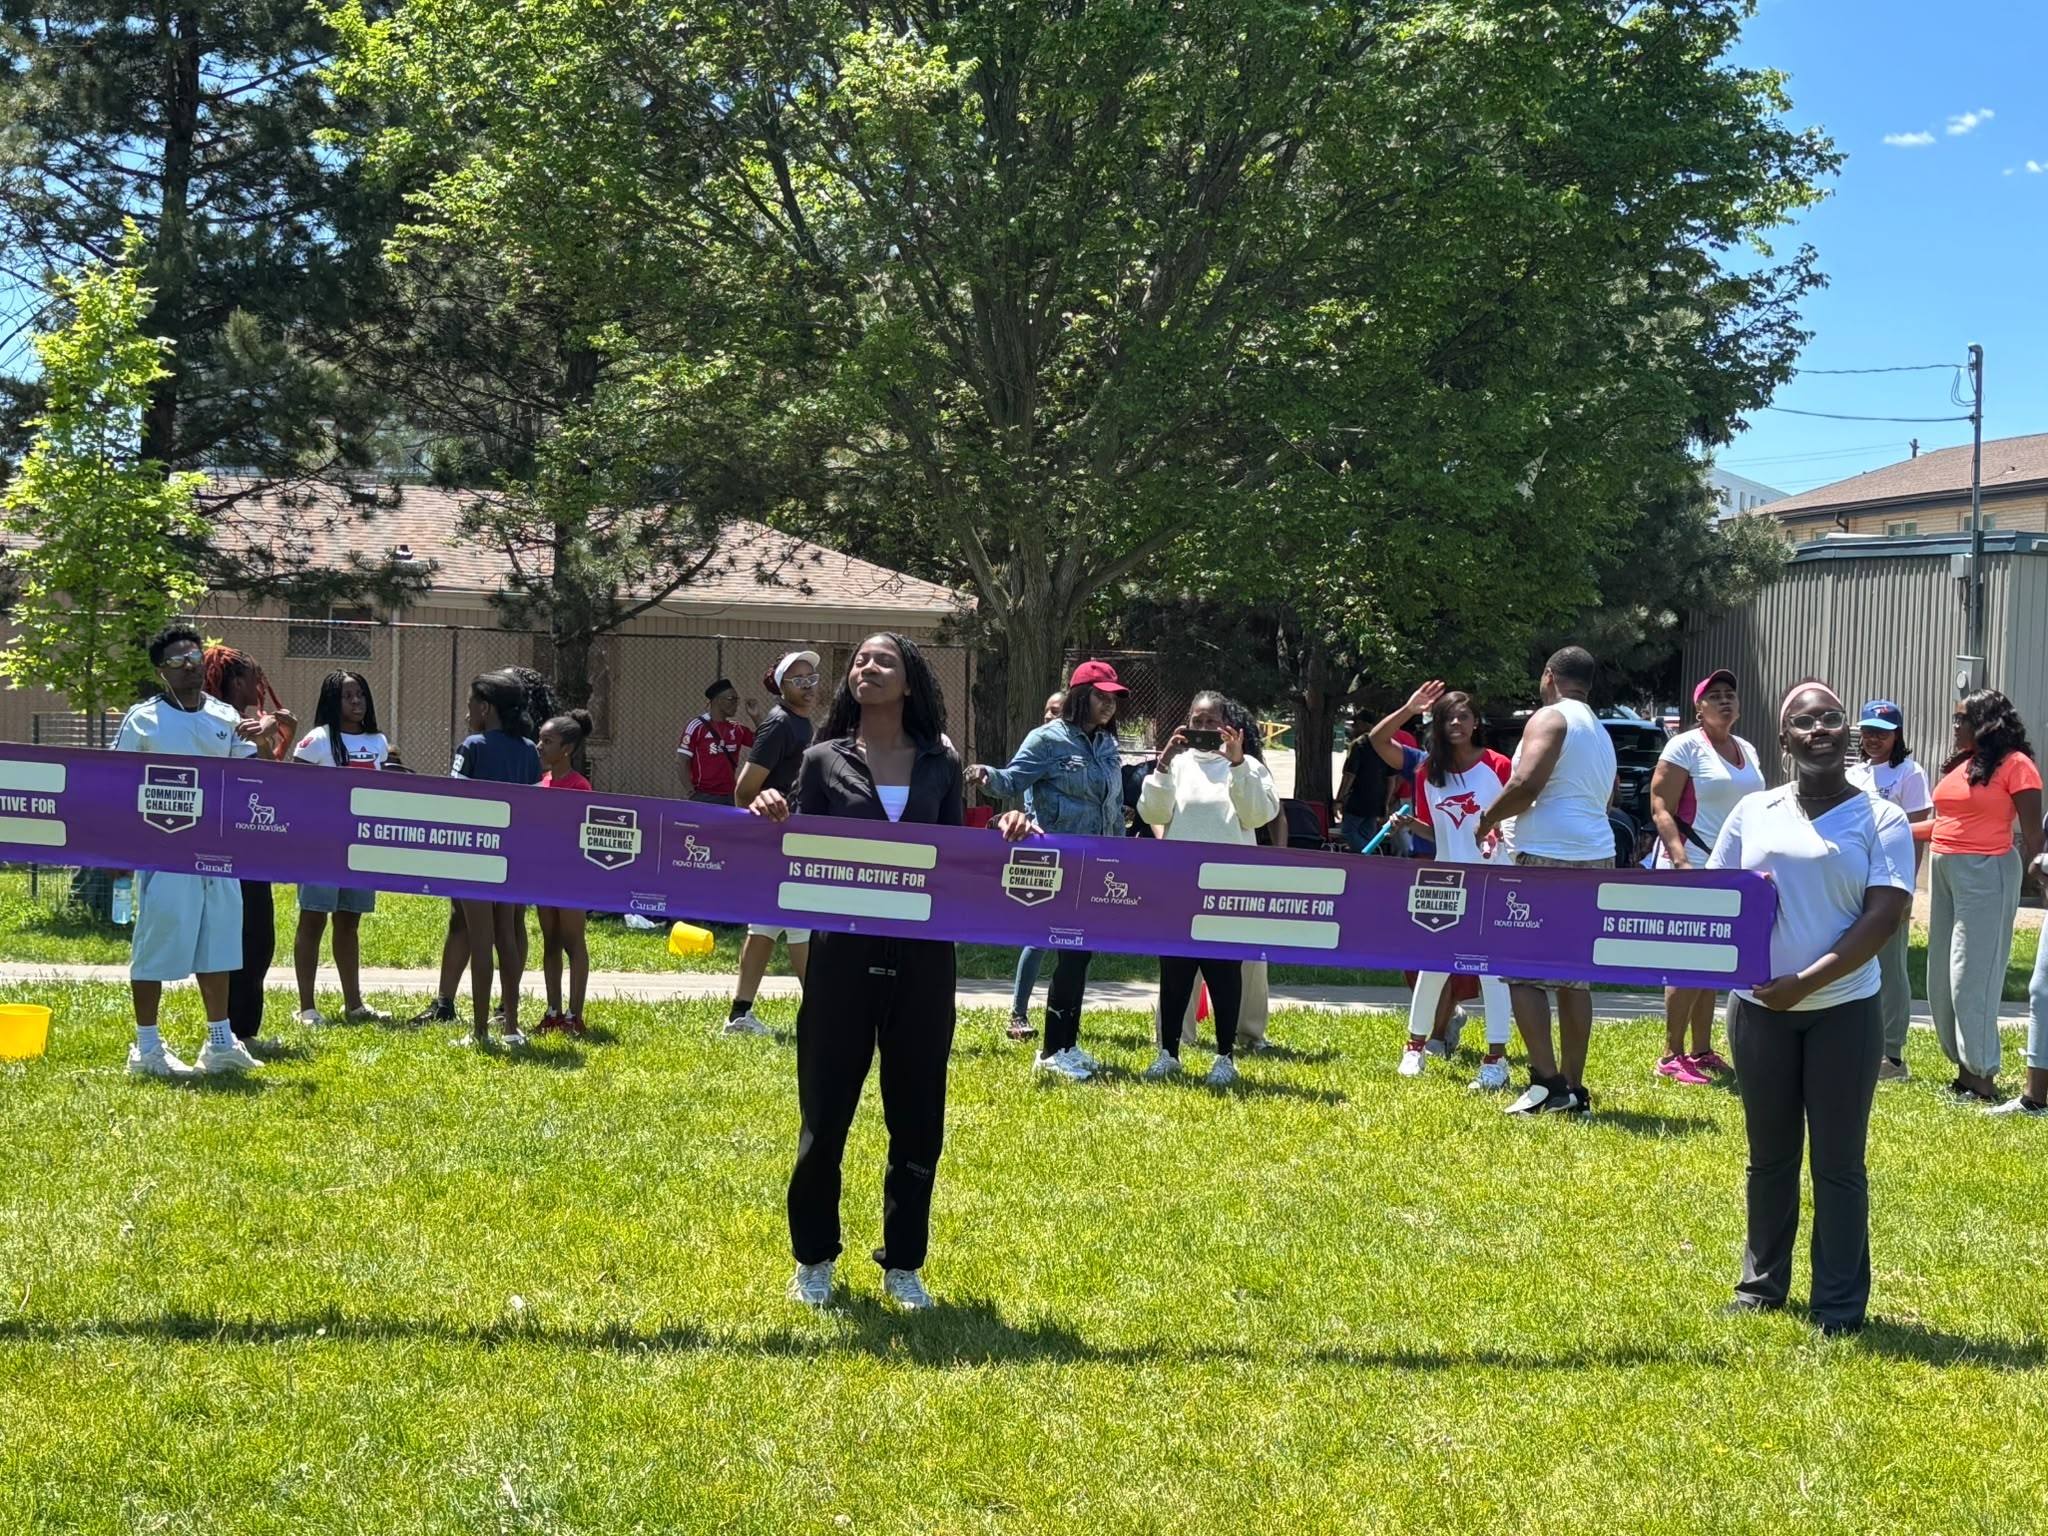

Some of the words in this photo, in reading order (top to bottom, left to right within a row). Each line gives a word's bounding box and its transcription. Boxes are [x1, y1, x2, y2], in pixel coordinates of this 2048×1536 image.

[144, 787, 197, 802] COMMUNITY
[31, 797, 56, 815] FOR
[146, 799, 194, 813] CHALLENGE
[235, 822, 256, 830] novo
[586, 826, 635, 840] COMMUNITY
[357, 822, 371, 839] IS
[374, 824, 425, 843] GETTING
[429, 828, 472, 847] ACTIVE
[476, 832, 500, 849] FOR
[587, 836, 633, 850] CHALLENGE
[672, 860, 692, 868] novo
[789, 861, 802, 877] IS
[805, 863, 854, 881] GETTING
[857, 868, 899, 885] ACTIVE
[902, 872, 926, 888] FOR
[1009, 866, 1057, 879] COMMUNITY
[1009, 876, 1055, 888] CHALLENGE
[1090, 896, 1110, 904] novo
[1414, 888, 1461, 901] COMMUNITY
[1203, 895, 1215, 910] IS
[1218, 895, 1266, 912] GETTING
[1268, 898, 1309, 914] ACTIVE
[1311, 900, 1335, 916] FOR
[1415, 899, 1458, 912] CHALLENGE
[1603, 916, 1615, 932] IS
[1618, 917, 1665, 935] GETTING
[1667, 920, 1706, 937] ACTIVE
[1710, 922, 1731, 939] FOR
